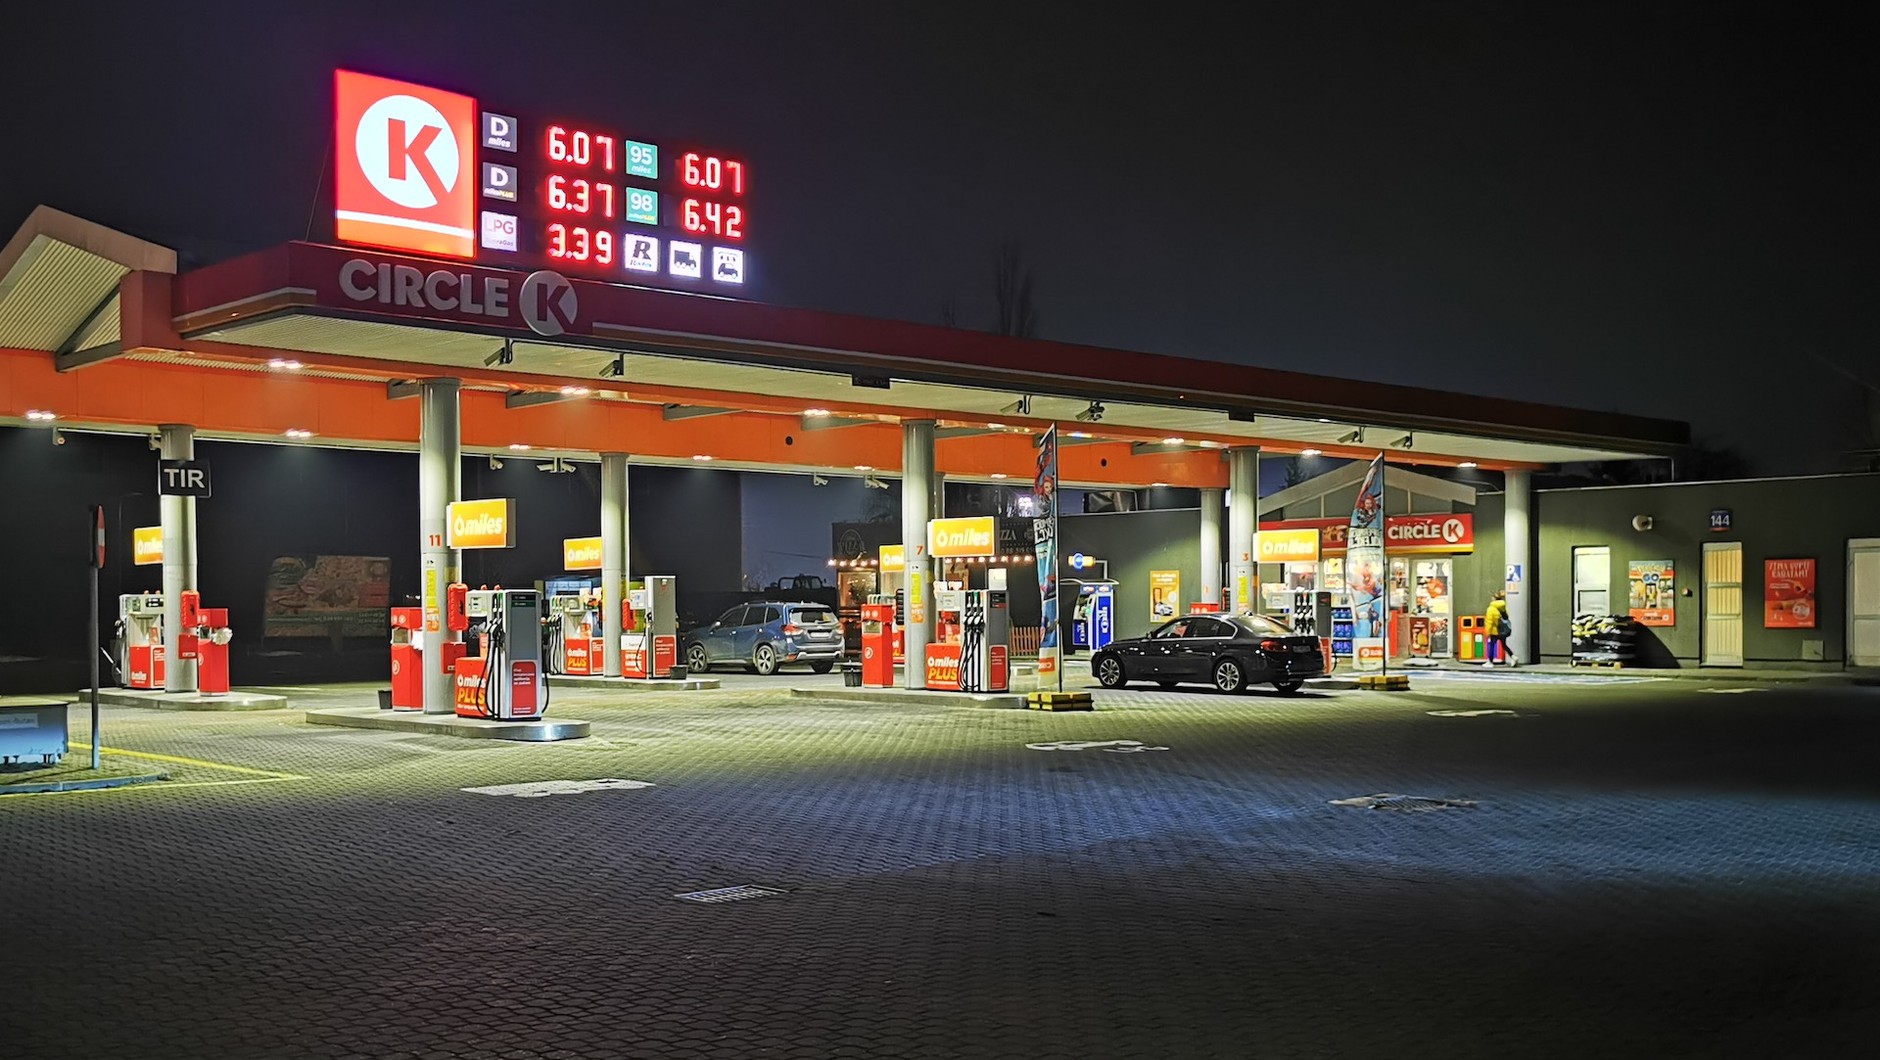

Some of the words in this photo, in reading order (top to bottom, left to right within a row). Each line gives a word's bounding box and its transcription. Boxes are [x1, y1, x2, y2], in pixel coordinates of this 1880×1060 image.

[490, 117, 509, 137] D
[488, 137, 511, 148] miles
[549, 126, 613, 170] 6.07
[630, 145, 653, 166] 95
[490, 166, 509, 187] D
[631, 164, 652, 175] miles
[685, 153, 742, 193] 6.07
[548, 175, 613, 218] 6.37
[630, 192, 653, 212] 98
[484, 217, 515, 235] LPG
[685, 199, 742, 238] 6.42
[548, 223, 612, 264] 3.39
[632, 240, 652, 260] R
[339, 258, 510, 317] CIRCLE
[164, 468, 205, 489] TIR
[465, 513, 503, 535] miles
[1710, 514, 1731, 527] 144
[949, 528, 990, 547] miles
[1387, 523, 1441, 540] CIRCLE
[429, 534, 442, 547] 11
[1274, 539, 1315, 555] miles
[573, 546, 600, 562] miles
[916, 545, 924, 556] 7
[1242, 552, 1249, 562] 3
[1506, 565, 1515, 578] P
[1642, 573, 1660, 583] GO
[567, 657, 588, 668] PLUS
[935, 657, 960, 668] miles
[928, 668, 958, 681] PLUS
[457, 688, 486, 705] PLUS
